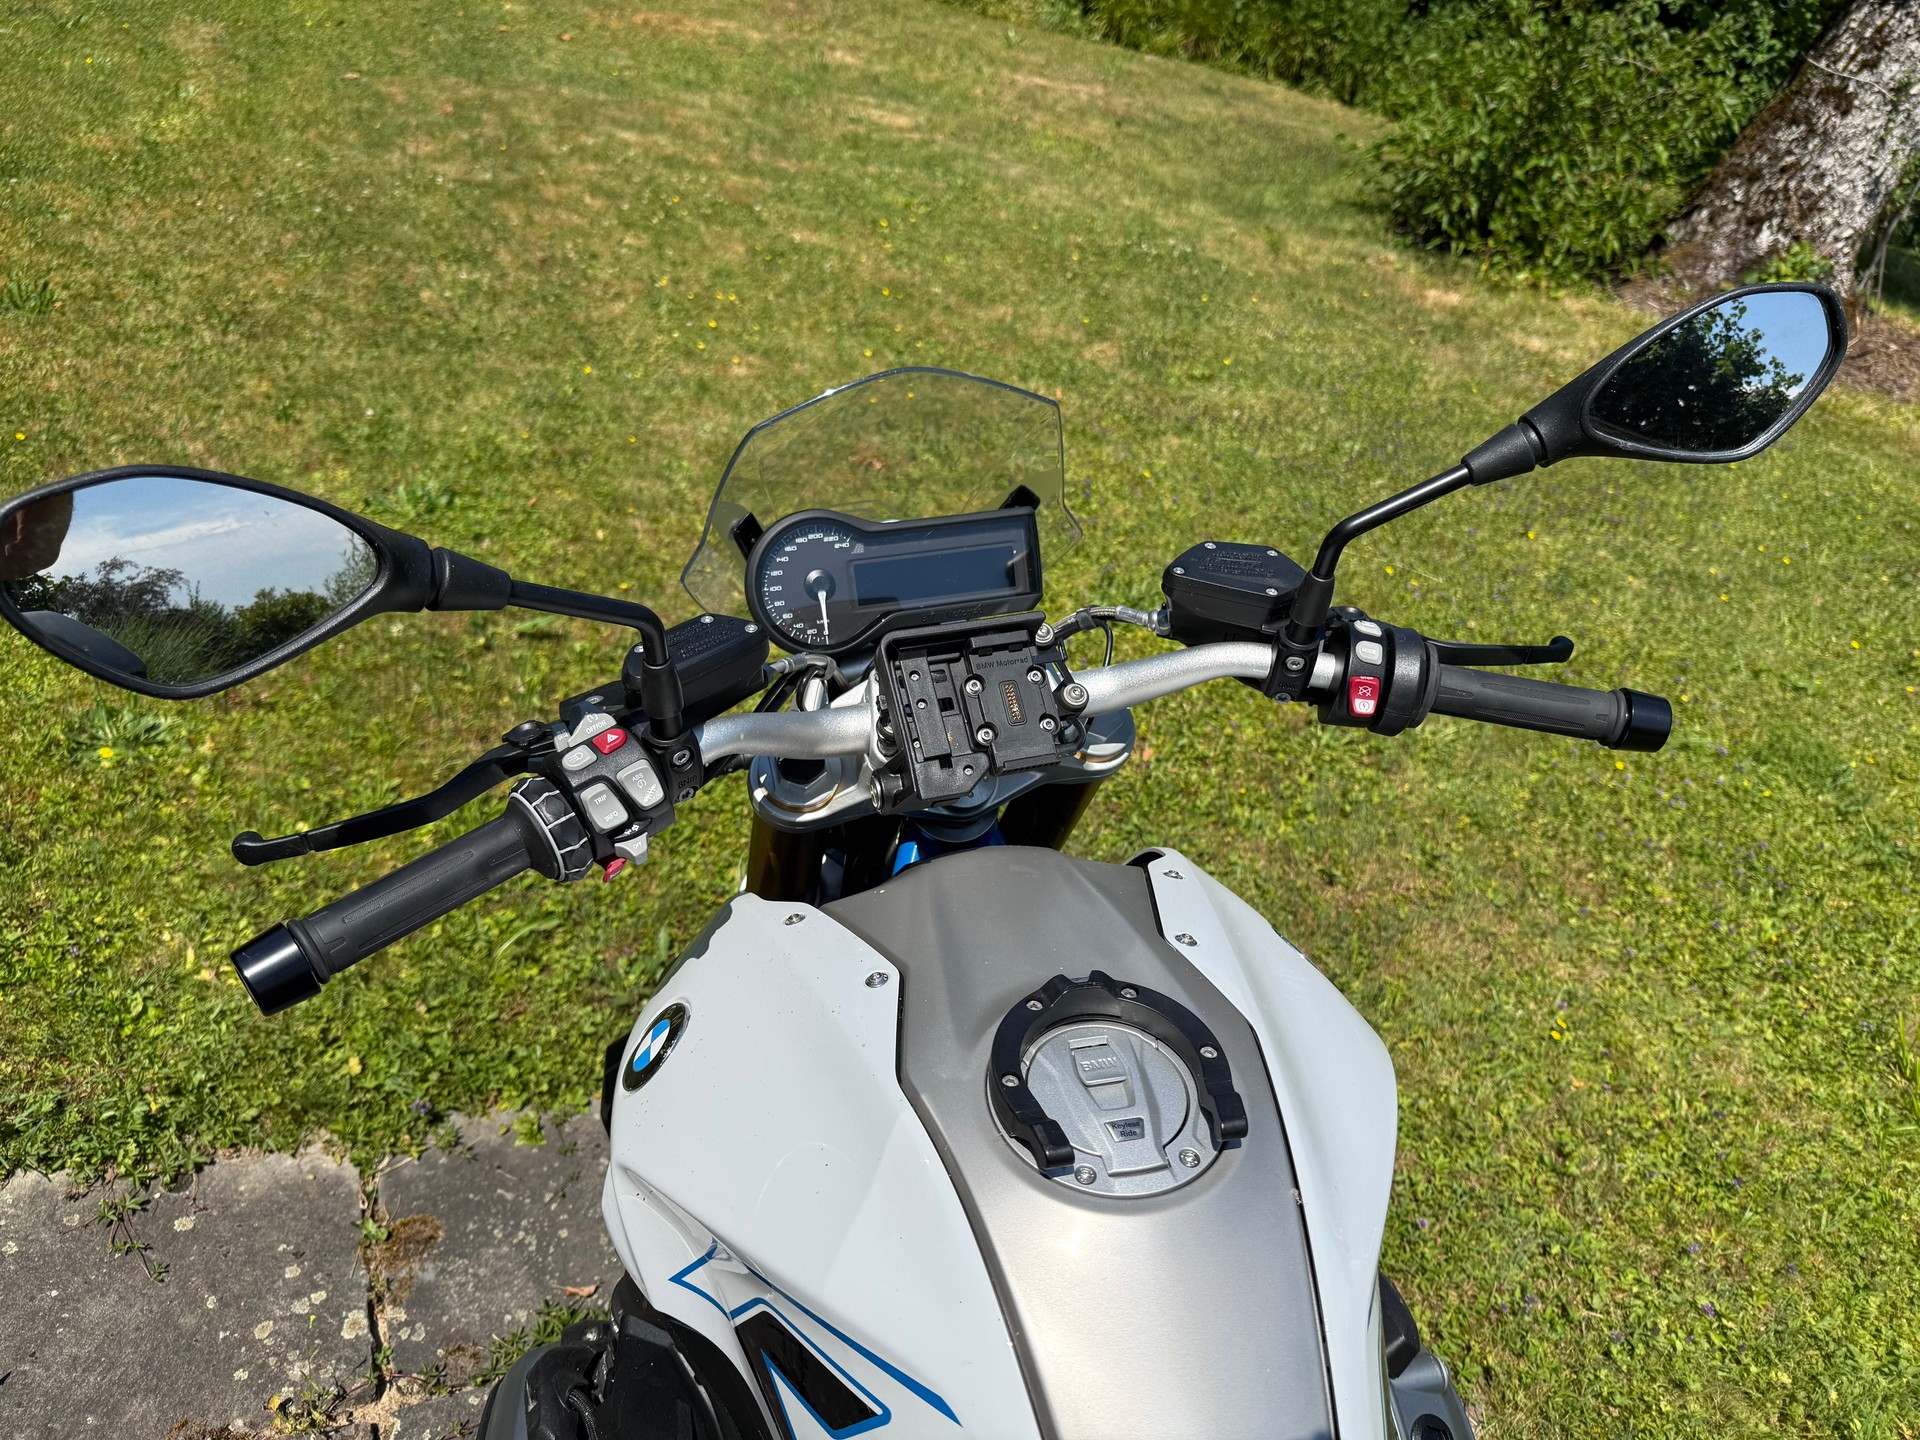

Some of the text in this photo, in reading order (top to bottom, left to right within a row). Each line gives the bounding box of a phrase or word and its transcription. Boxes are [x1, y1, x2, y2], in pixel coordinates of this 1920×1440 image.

[976, 656, 1029, 670] BMW Motorrad
[586, 720, 606, 735] OFF/ON
[632, 772, 644, 782] ABS
[678, 774, 698, 789] 8Nm
[594, 794, 607, 806] TRIP
[604, 810, 619, 822] INFO
[632, 841, 642, 850] OFF
[1080, 1056, 1117, 1072] BMW
[1112, 1121, 1140, 1130] Keyless
[1120, 1129, 1137, 1138] Ride
